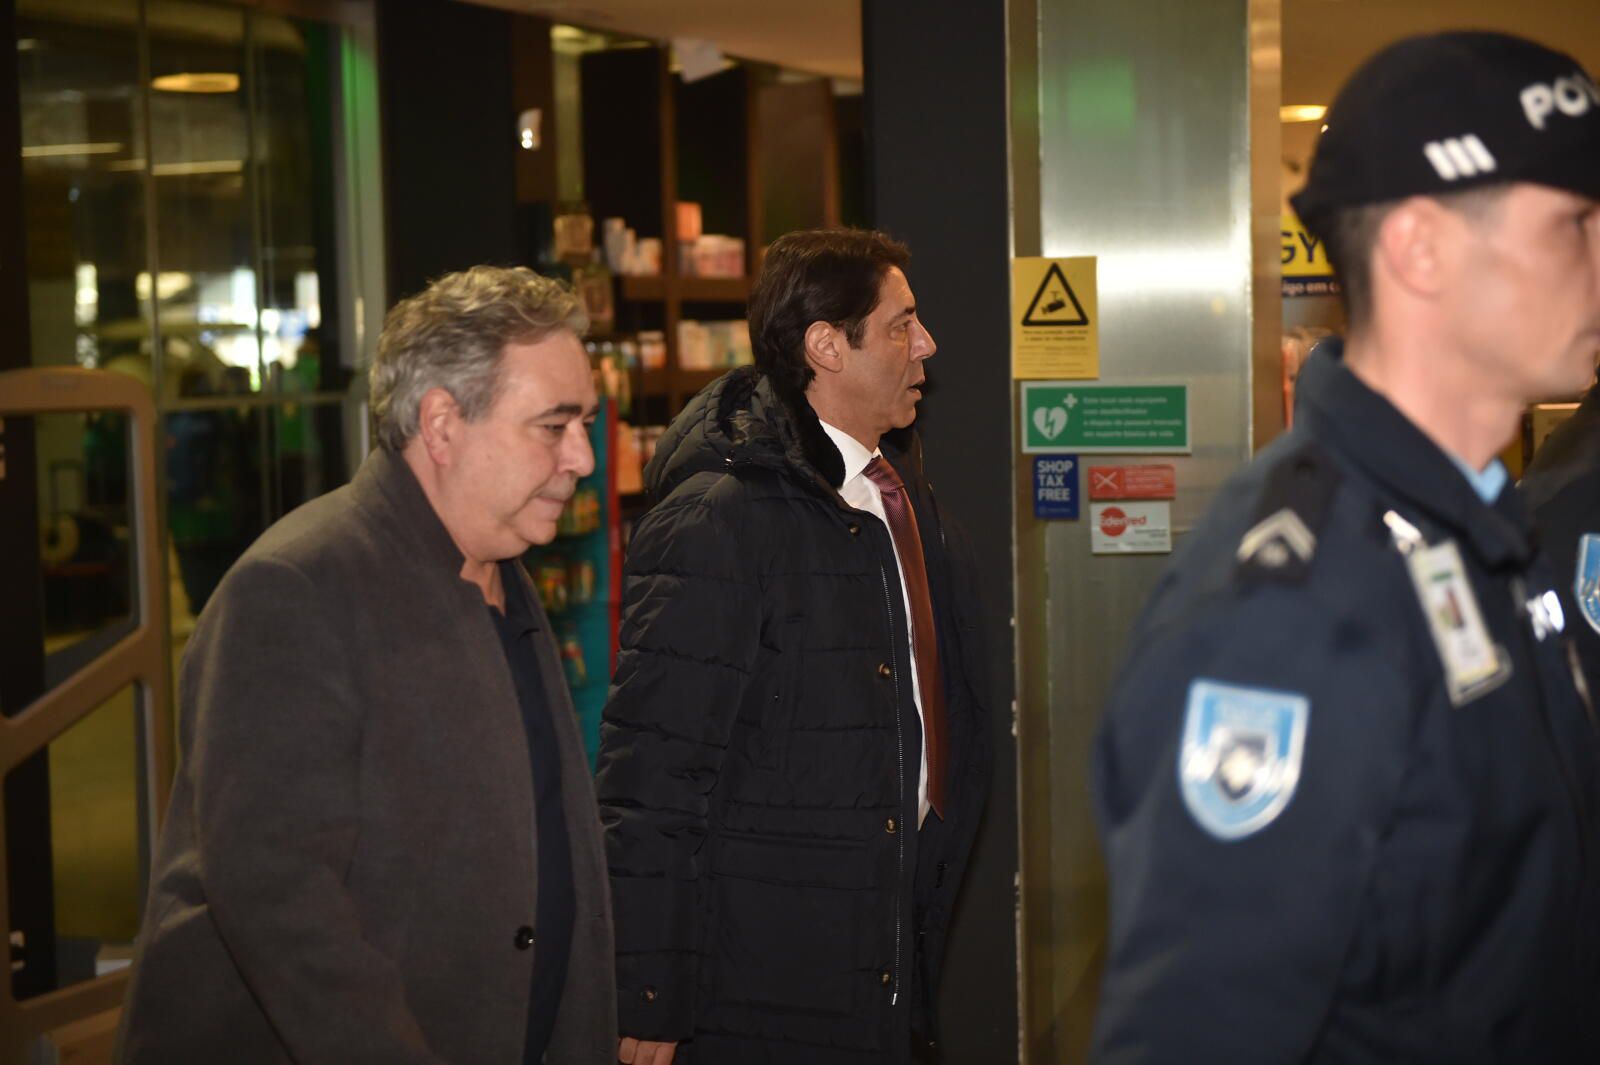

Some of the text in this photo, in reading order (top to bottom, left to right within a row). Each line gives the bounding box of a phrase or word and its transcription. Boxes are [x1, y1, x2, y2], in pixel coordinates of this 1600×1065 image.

[1037, 460, 1074, 473] SHOP
[1037, 474, 1065, 487] TAX
[1037, 487, 1071, 501] FREE
